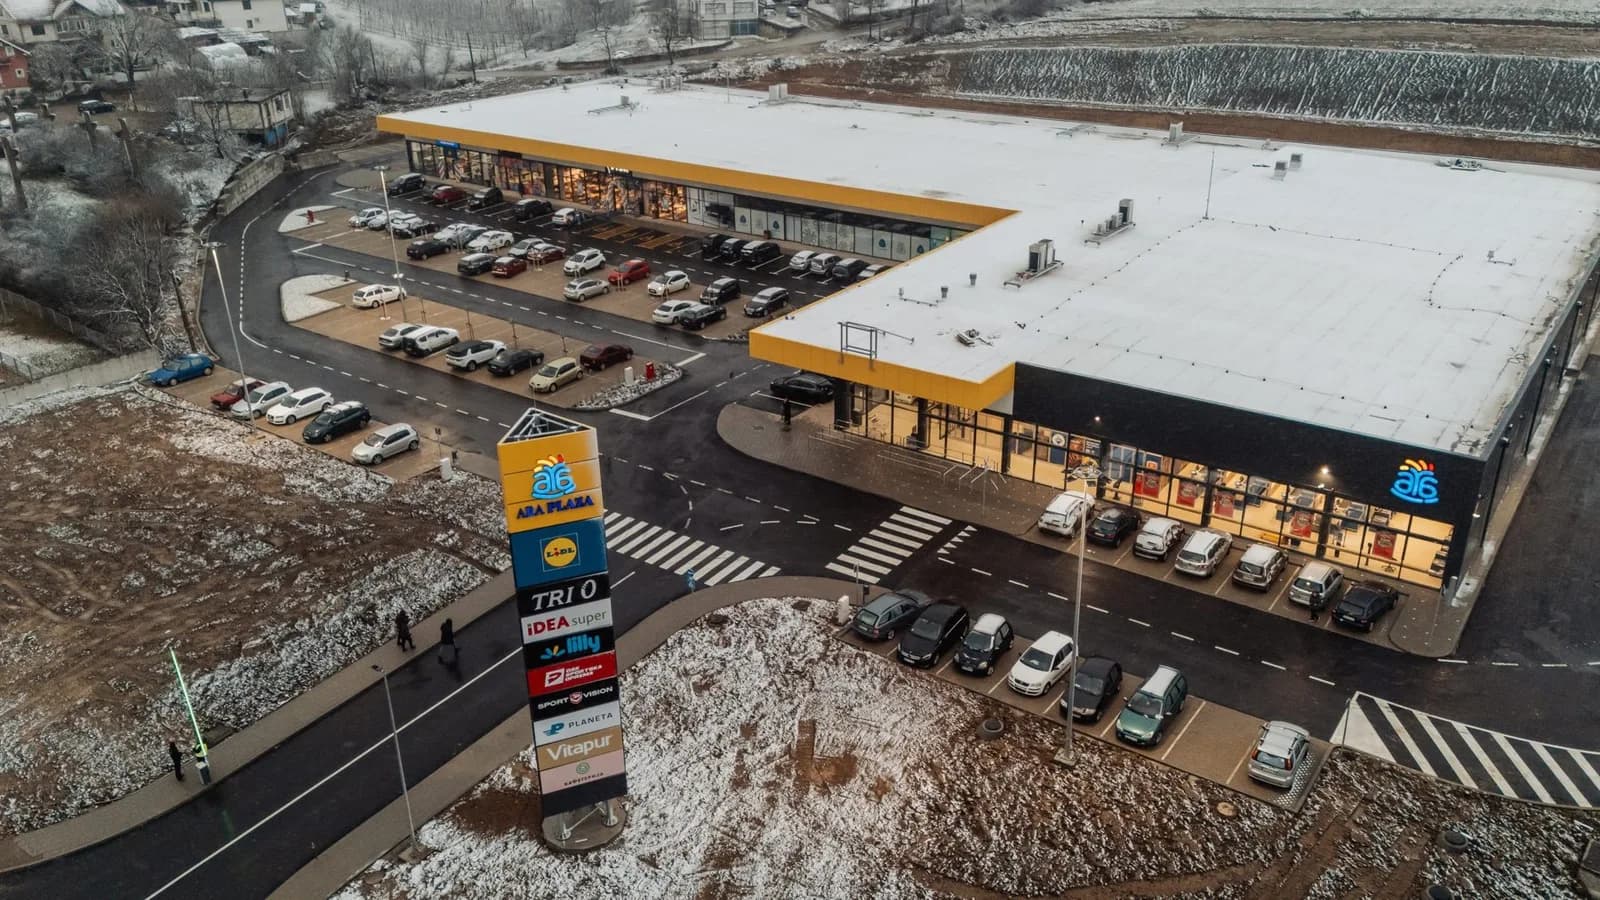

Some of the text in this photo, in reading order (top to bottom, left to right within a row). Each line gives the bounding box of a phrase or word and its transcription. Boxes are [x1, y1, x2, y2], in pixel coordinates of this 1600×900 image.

[516, 495, 594, 520] ARA PLAZA
[572, 611, 607, 626] super
[567, 634, 601, 653] lilly
[538, 686, 613, 710] SPORT VISION
[568, 712, 613, 728] PLANETA
[546, 735, 613, 761] Vitapur
